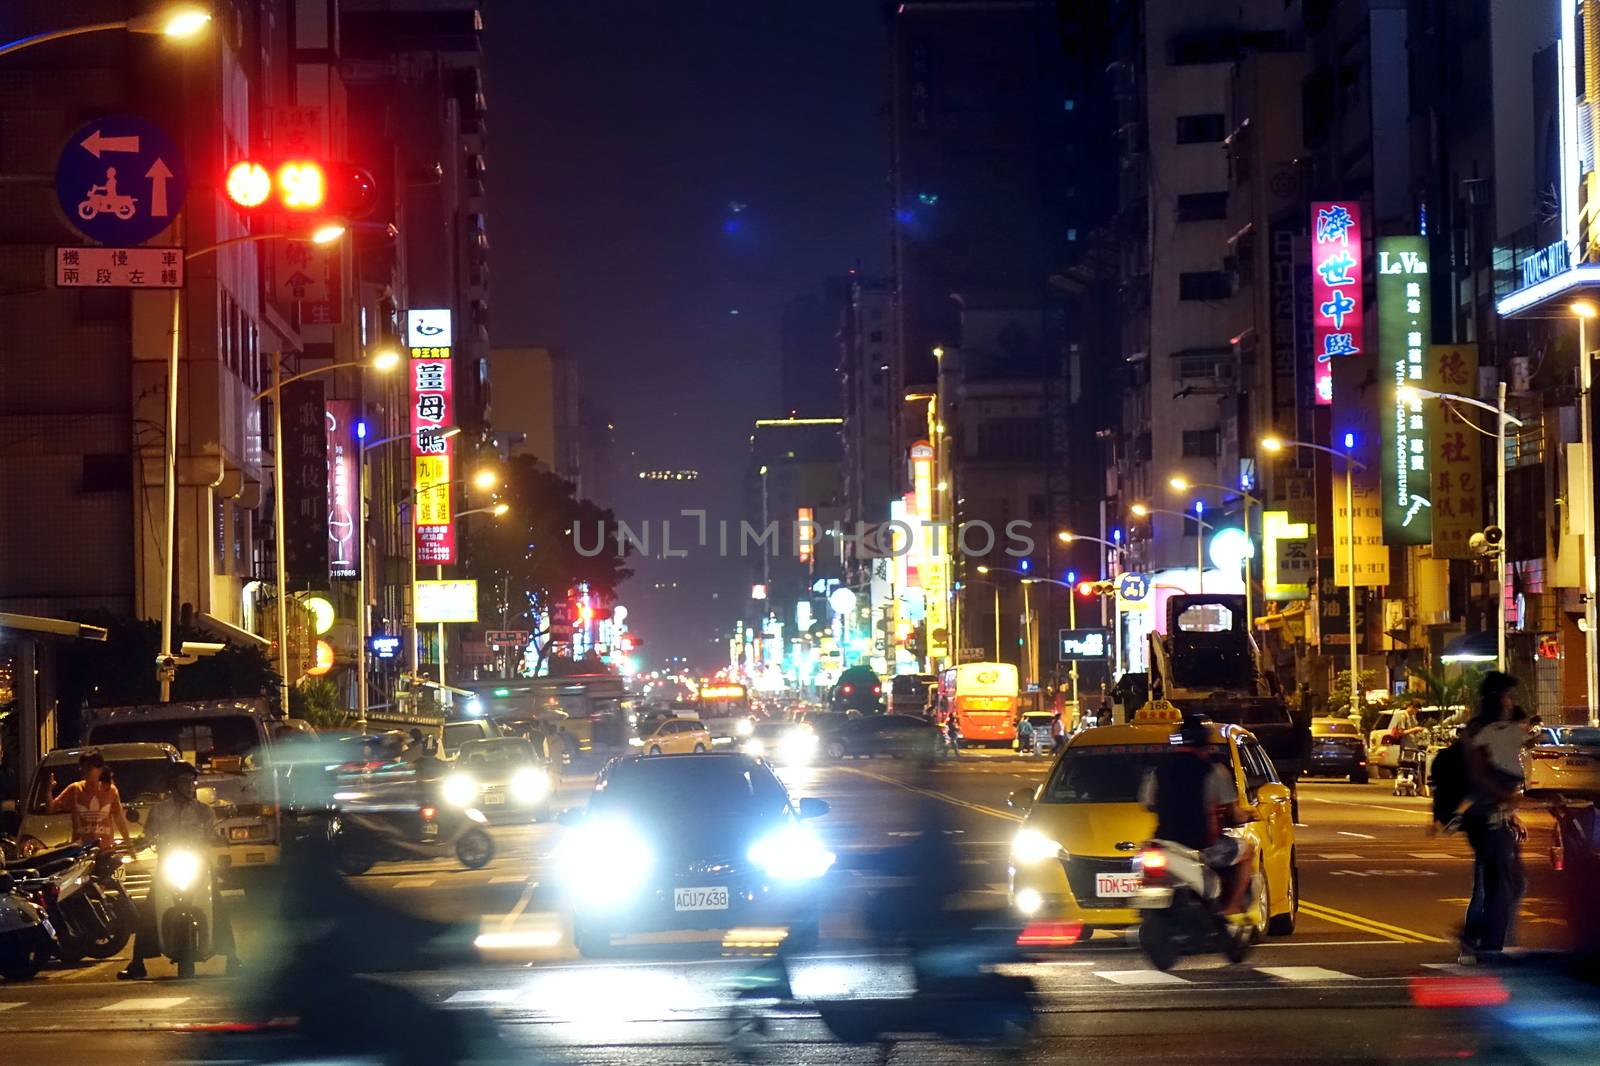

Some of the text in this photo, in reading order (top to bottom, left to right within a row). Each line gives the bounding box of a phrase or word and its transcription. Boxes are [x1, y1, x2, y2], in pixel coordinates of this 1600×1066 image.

[63, 251, 178, 267] 機慢車
[63, 268, 178, 286] 兩段左轉
[416, 363, 446, 453] 薑母鴨
[299, 401, 321, 520] 歌舞伎町
[1150, 702, 1169, 711] 166
[1098, 878, 1143, 894] TDK-50
